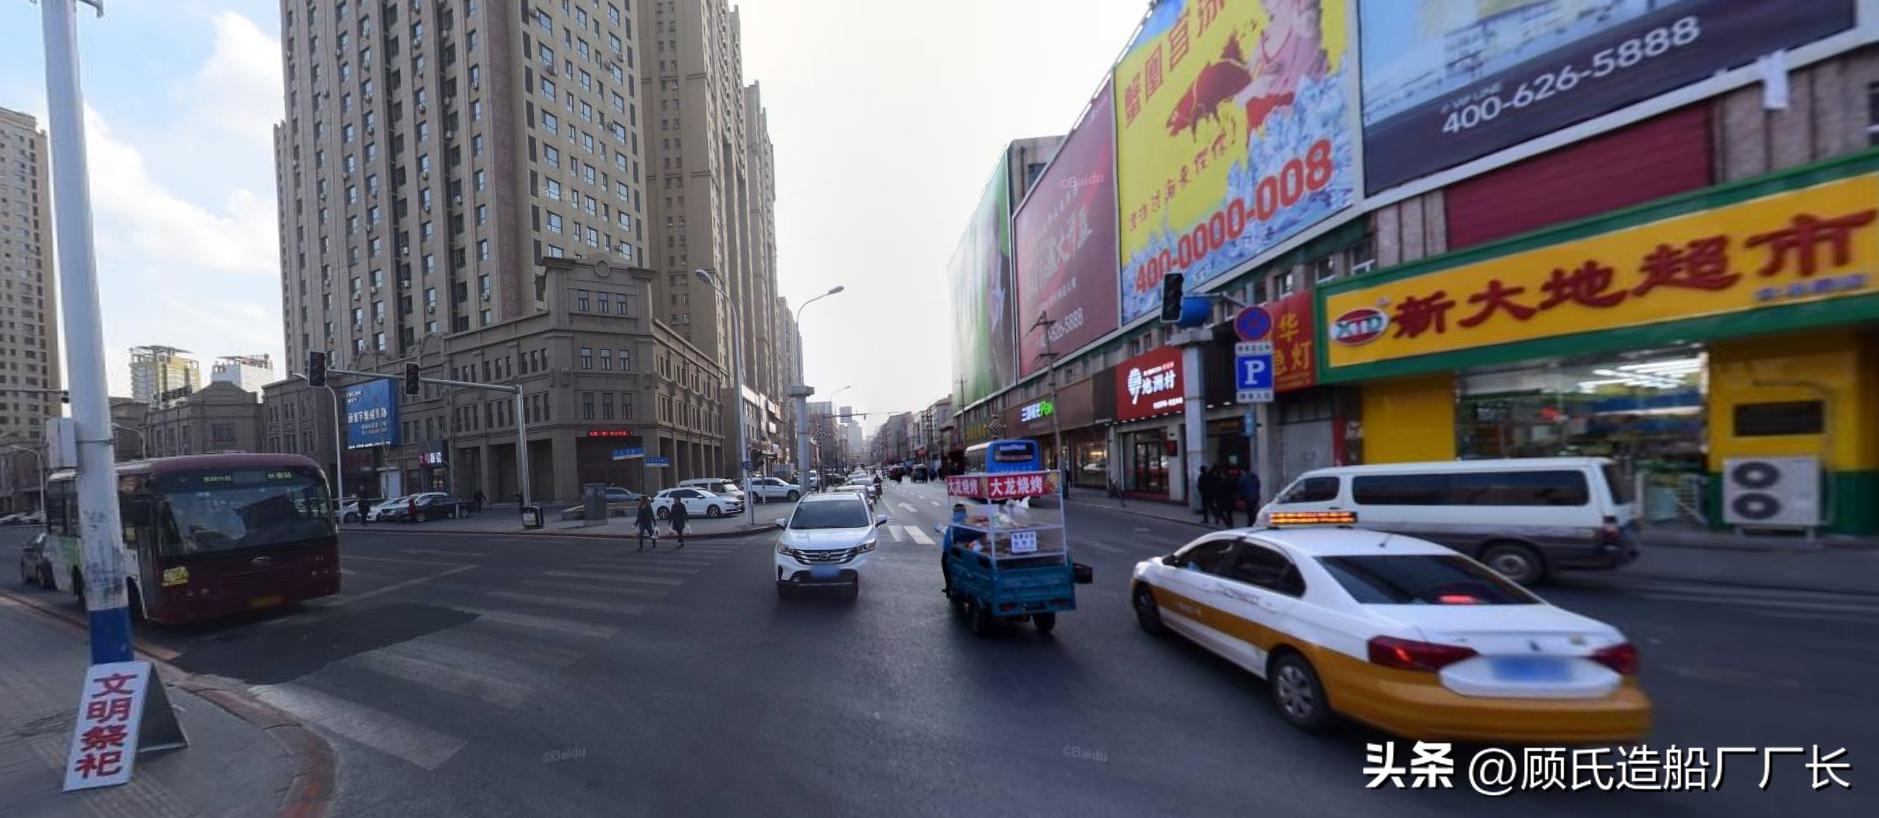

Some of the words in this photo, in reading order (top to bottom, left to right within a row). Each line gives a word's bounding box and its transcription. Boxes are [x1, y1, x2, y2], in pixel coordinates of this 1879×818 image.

[1442, 15, 1700, 135] 400-626-5888
[1135, 138, 1334, 293] 400-0000-008
[1391, 209, 1877, 339] 新大地超市
[1243, 359, 1265, 385] P
[990, 475, 1043, 497] 大龙烧烤
[75, 673, 138, 779] 文明祭祀
